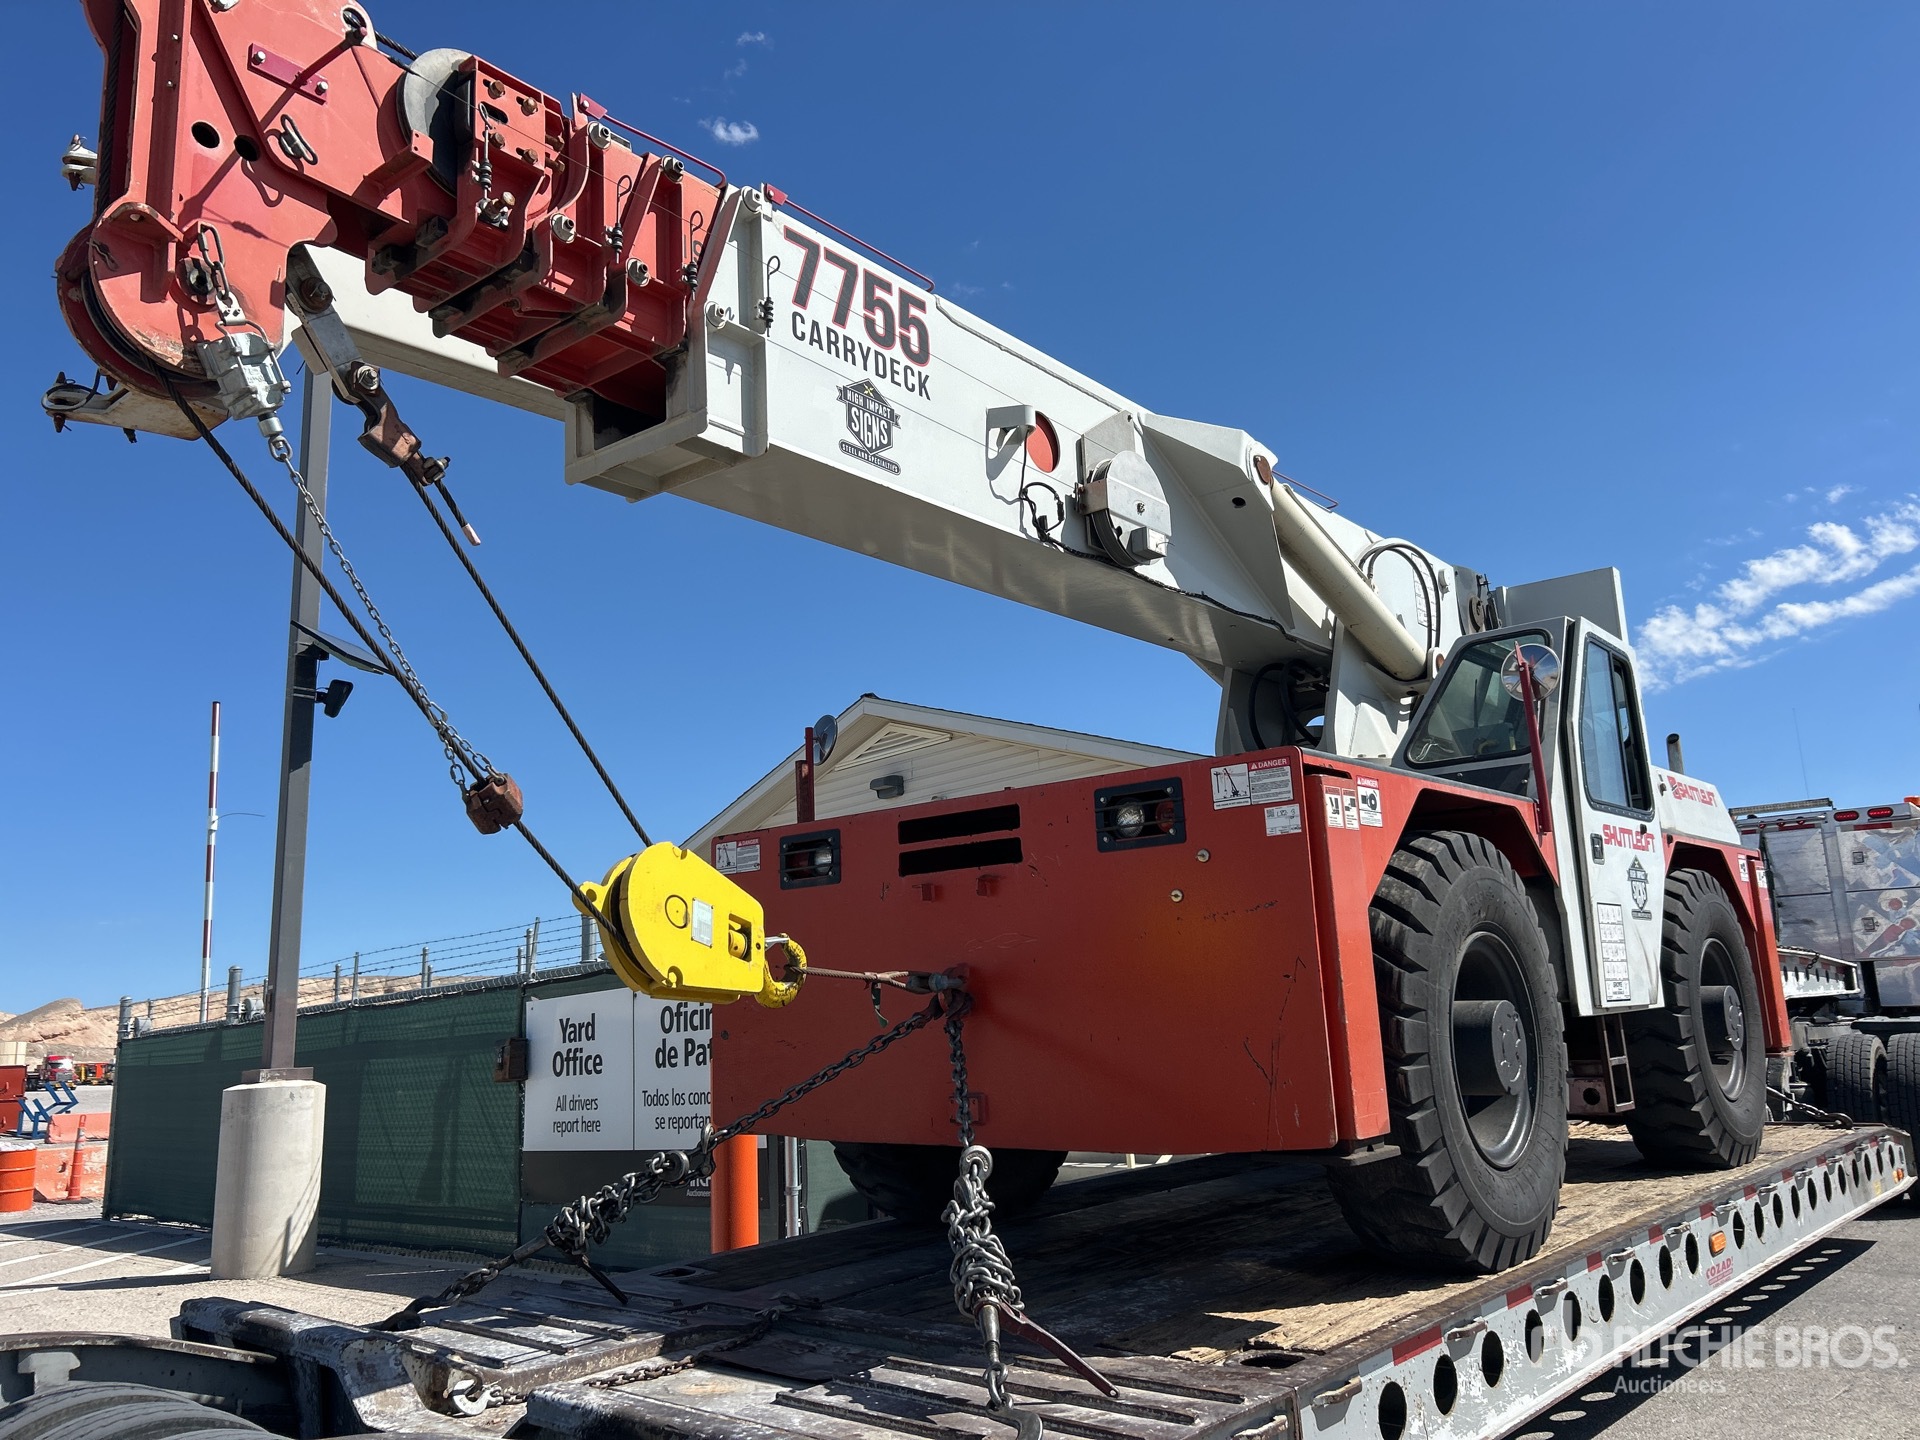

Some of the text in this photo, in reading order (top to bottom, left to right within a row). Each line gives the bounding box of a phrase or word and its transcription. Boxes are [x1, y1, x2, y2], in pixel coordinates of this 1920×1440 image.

[784, 225, 931, 367] 7755
[791, 311, 931, 401] CARRYDECK
[846, 389, 891, 419] HIGH IMPACT
[851, 406, 888, 450] SIGNS
[1258, 758, 1287, 768] DANGER
[559, 1012, 596, 1044] Yard
[552, 1047, 603, 1077] Office
[655, 1037, 679, 1069] de
[555, 1094, 599, 1112] All drivers
[642, 1088, 670, 1107] Todos
[671, 1087, 686, 1106] los
[552, 1115, 602, 1138] report here
[655, 1116, 666, 1130] se
